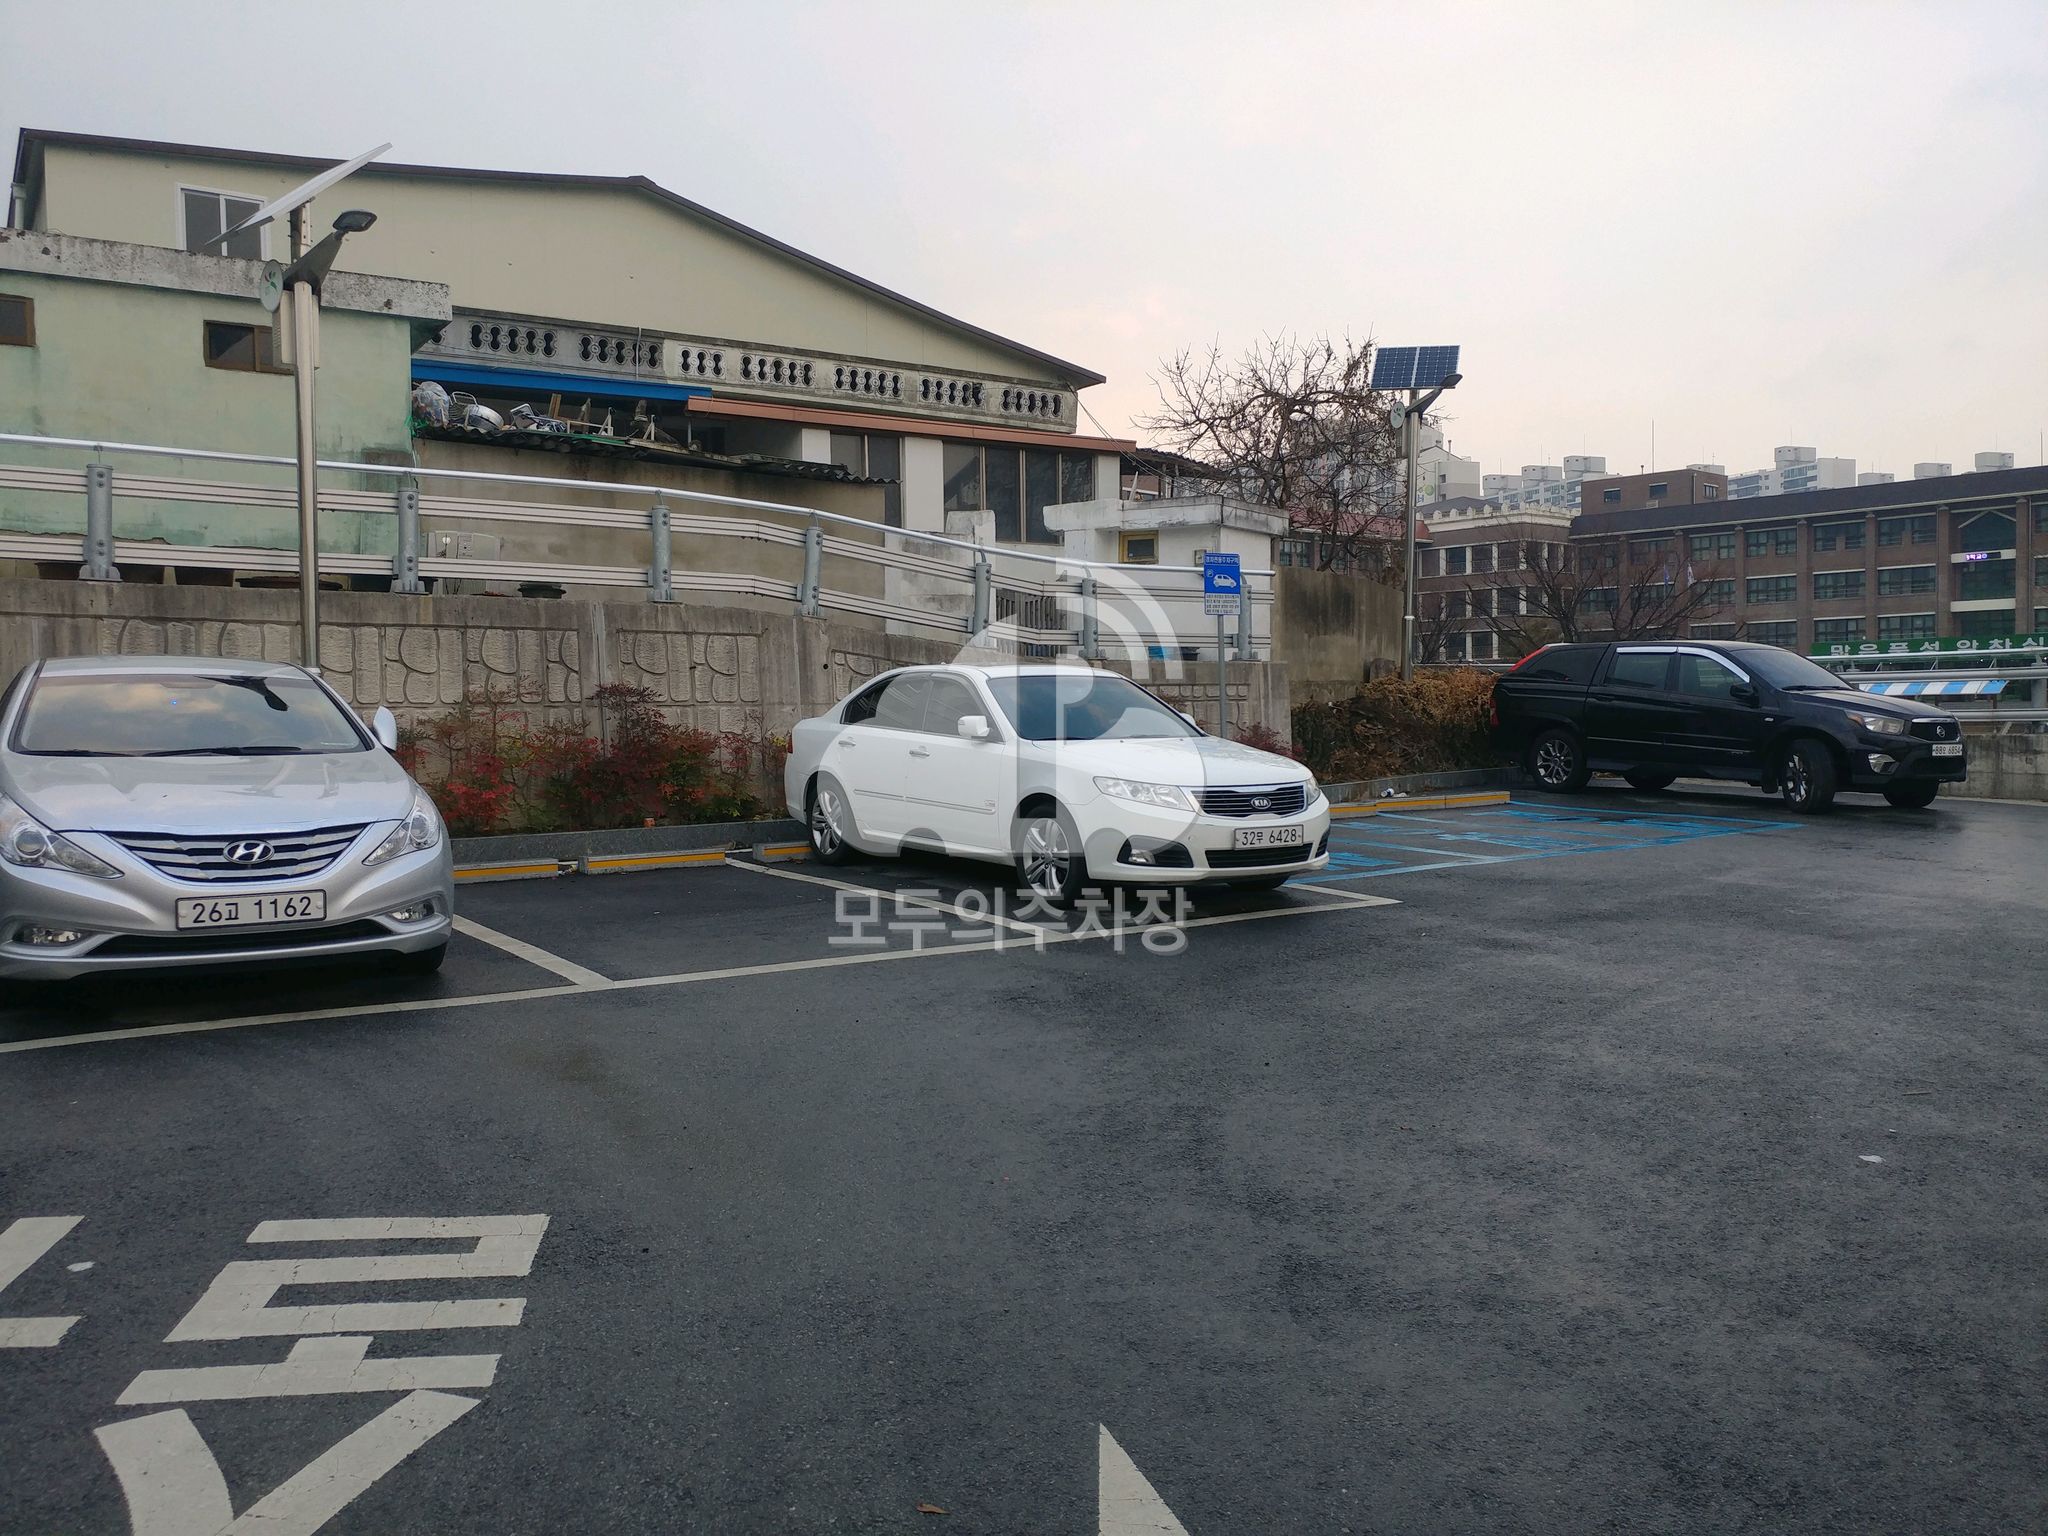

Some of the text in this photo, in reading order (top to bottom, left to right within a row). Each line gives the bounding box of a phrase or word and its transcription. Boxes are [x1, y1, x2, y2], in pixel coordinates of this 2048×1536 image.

[1253, 799, 1269, 807] KIA
[1268, 828, 1297, 844] 6428
[192, 895, 312, 924] 26고 1162
